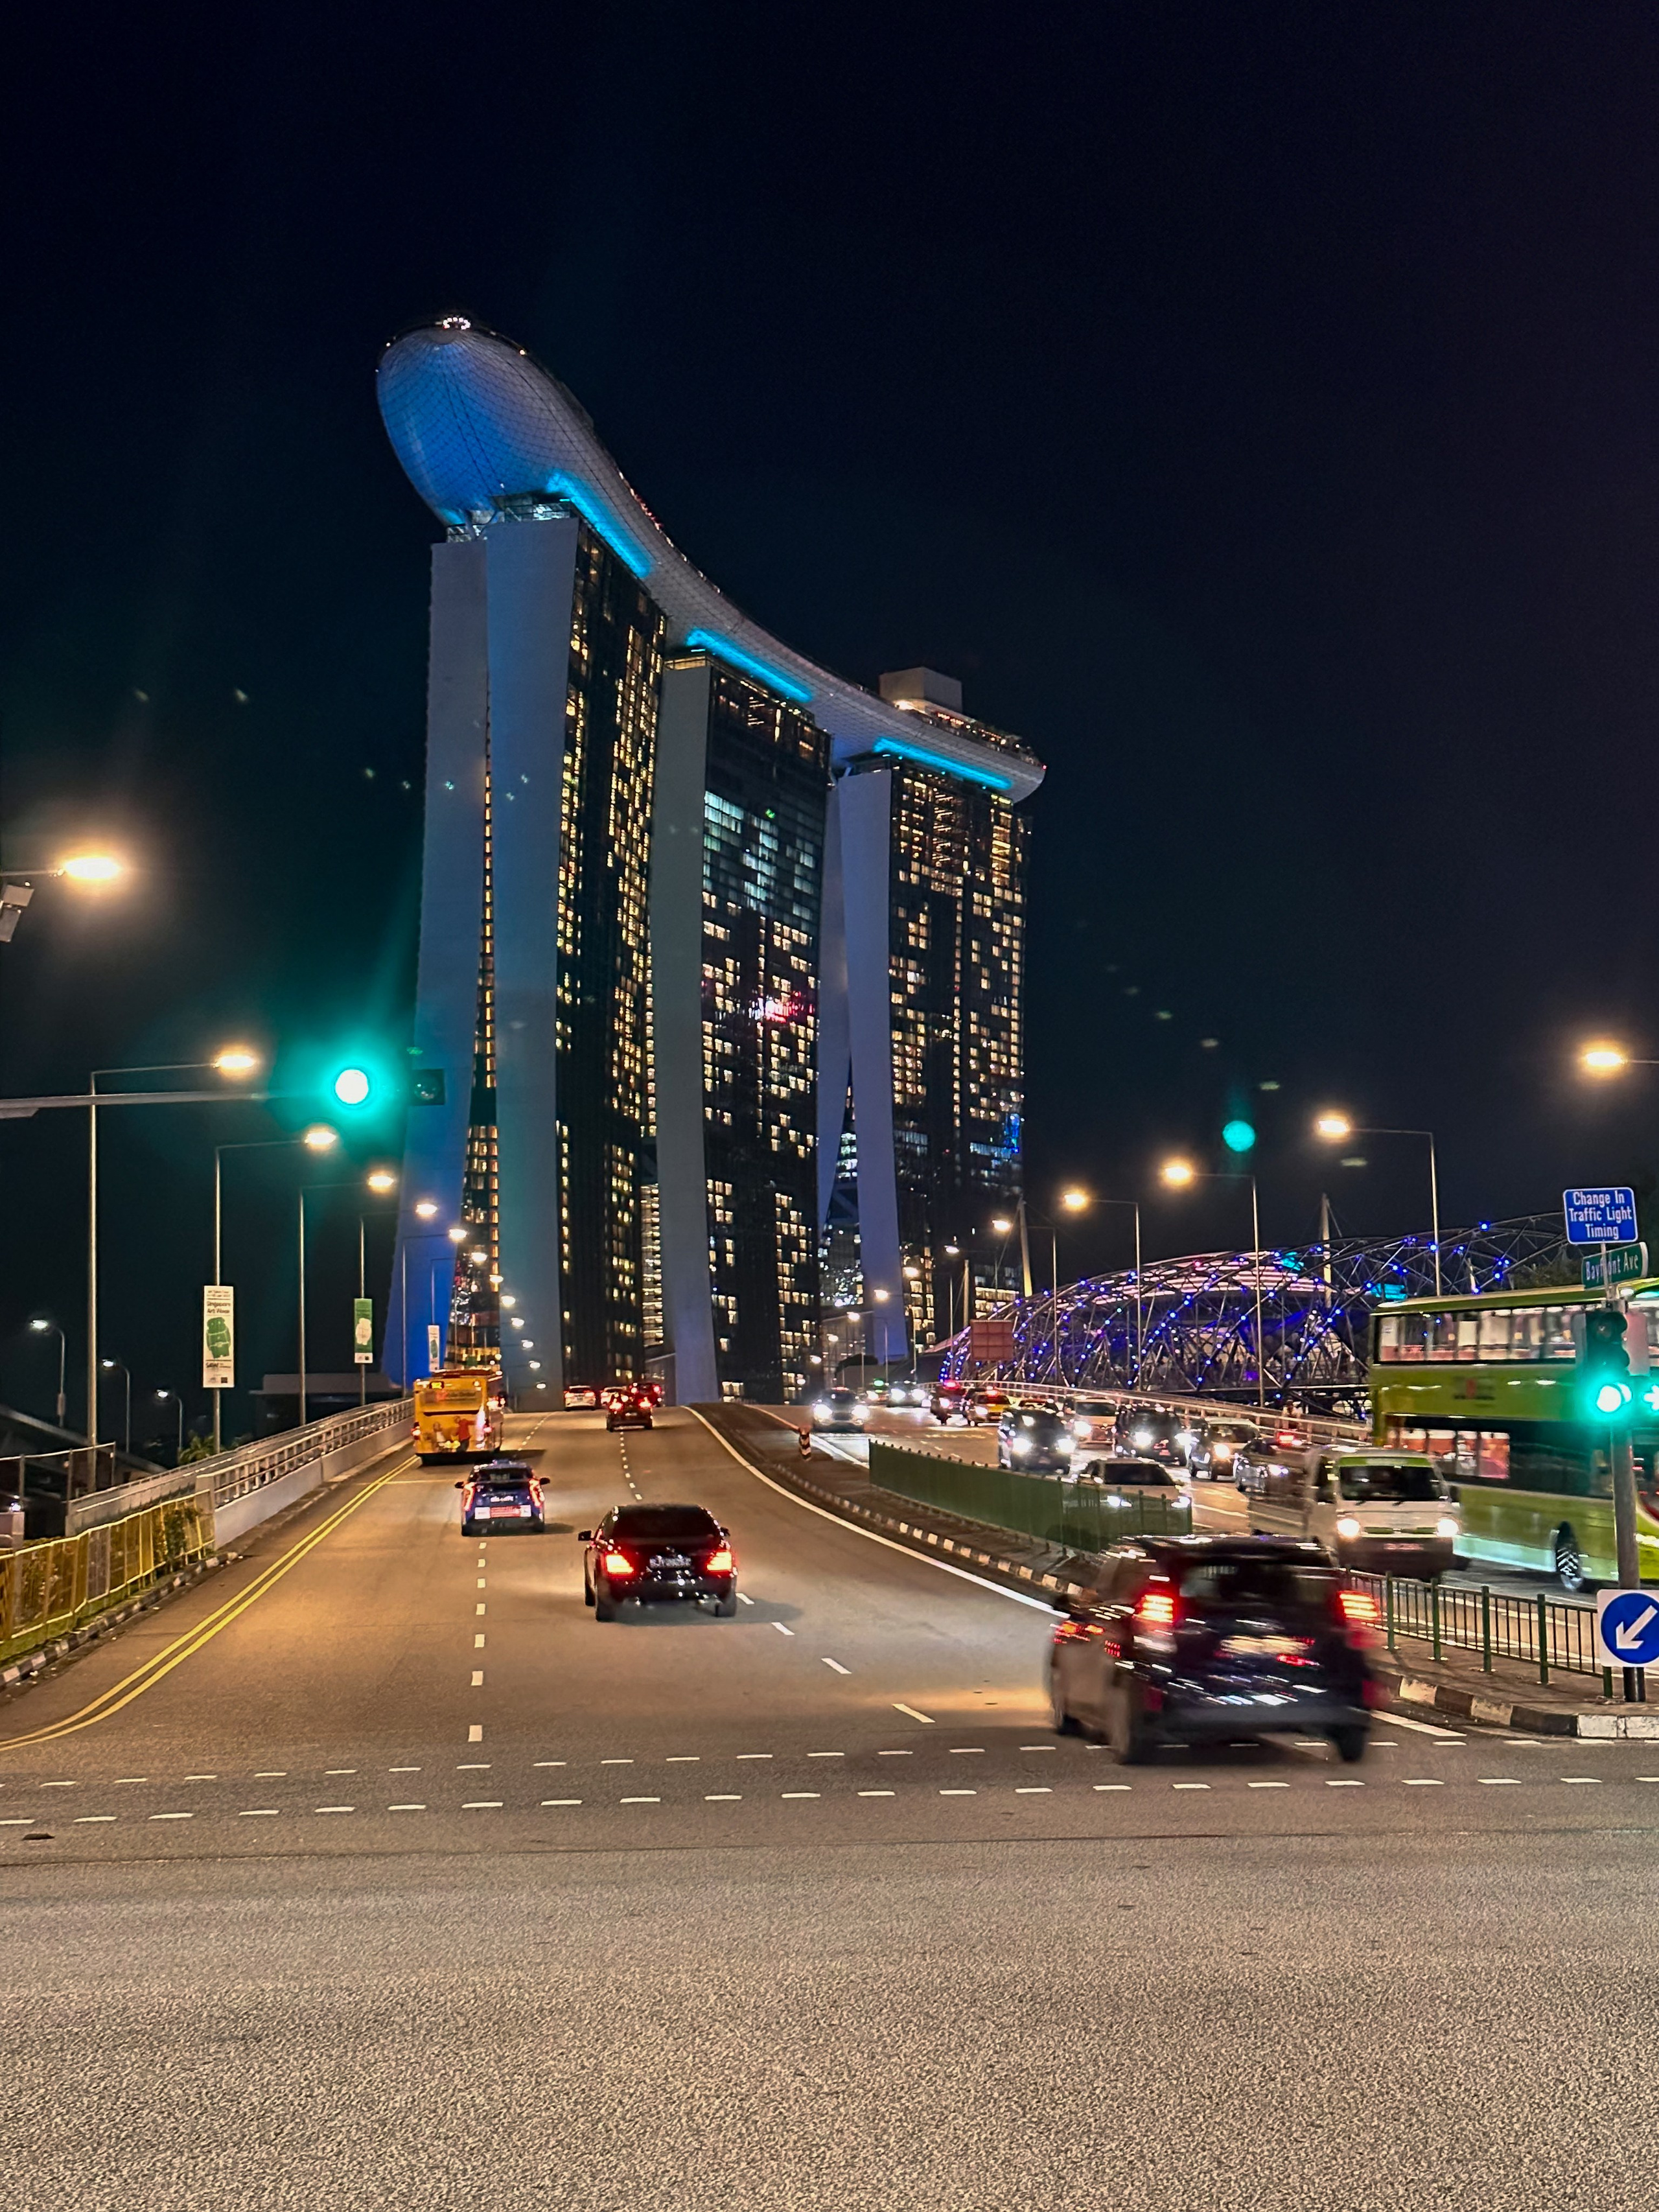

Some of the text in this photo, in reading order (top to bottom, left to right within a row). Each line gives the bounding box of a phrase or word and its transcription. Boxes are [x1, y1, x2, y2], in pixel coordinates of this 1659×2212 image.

[1572, 1190, 1625, 1208] Change In
[1568, 1205, 1633, 1224] Traffic Light
[1585, 1222, 1619, 1240] Timing
[1586, 1251, 1639, 1283] Bayfont Ave
